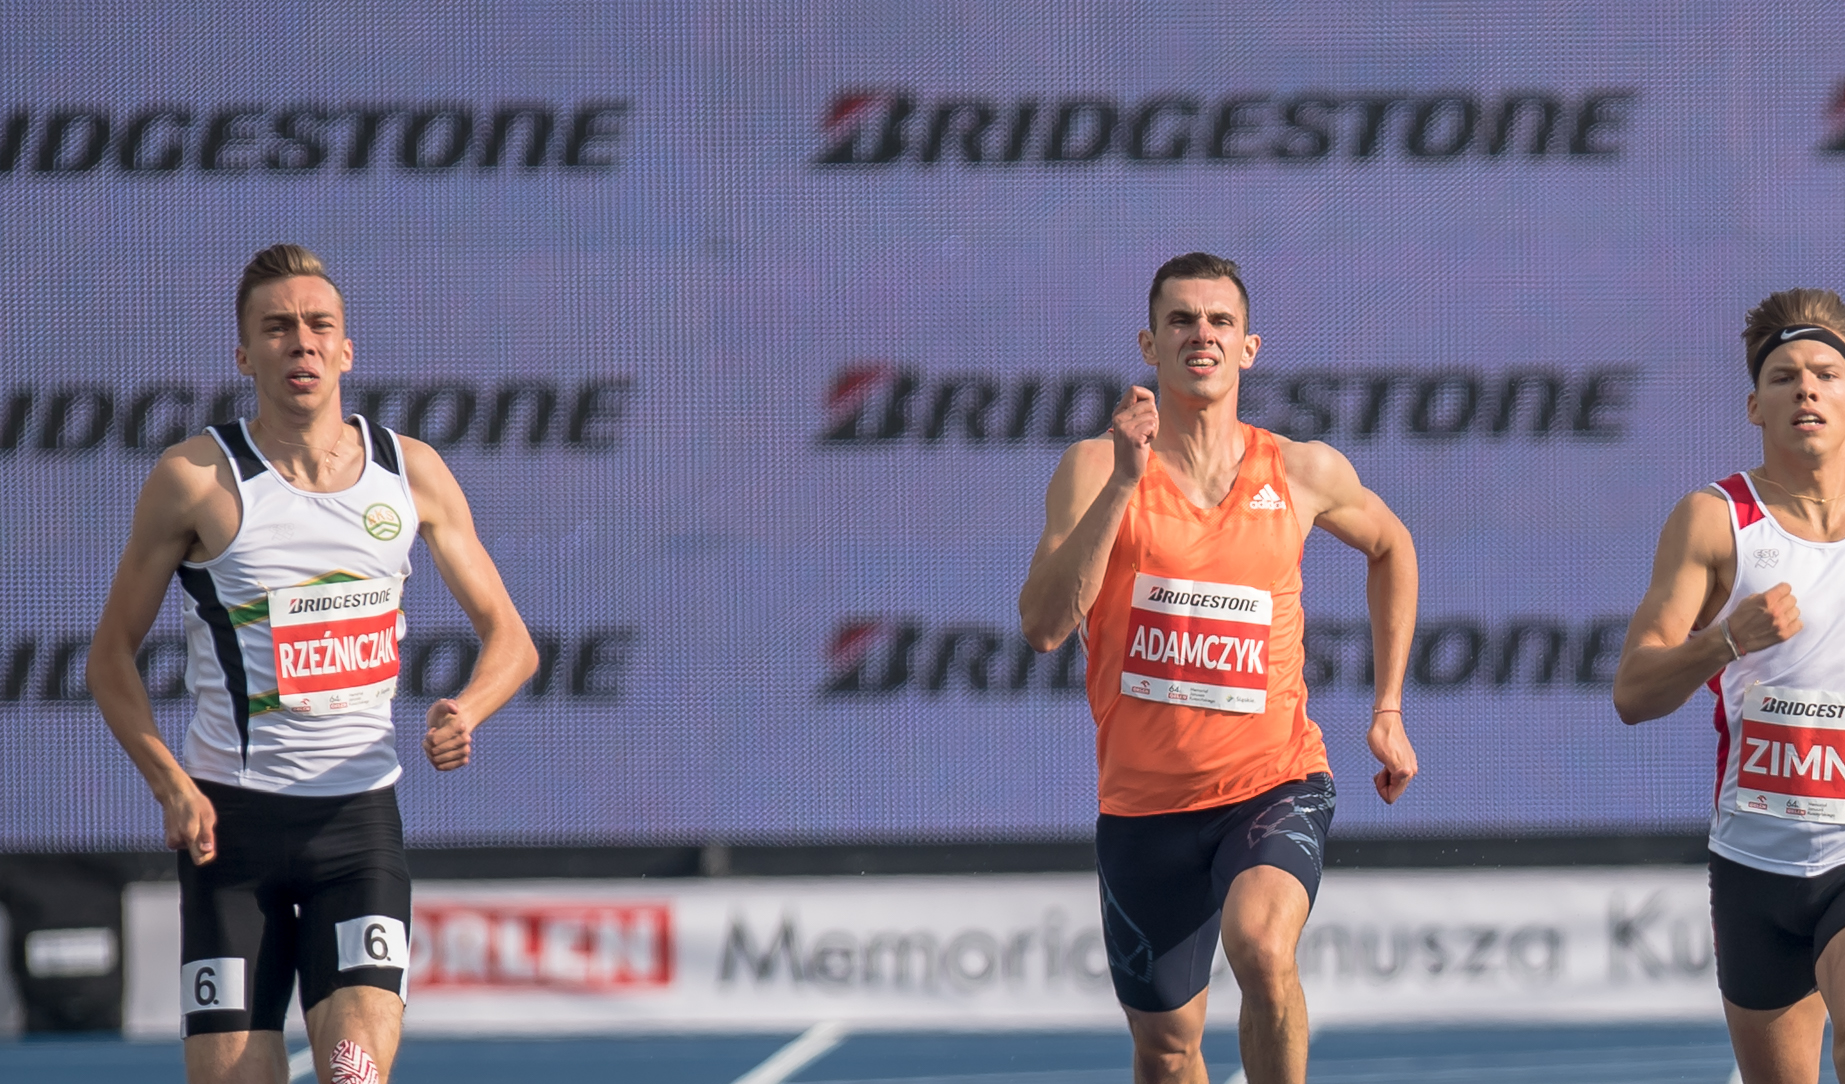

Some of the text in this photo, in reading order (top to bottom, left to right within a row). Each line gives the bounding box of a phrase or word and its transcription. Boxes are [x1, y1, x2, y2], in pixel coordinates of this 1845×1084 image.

[818, 90, 1634, 164] BRIDGESTONE
[820, 368, 1638, 440] BRIDSTONE
[289, 588, 391, 614] BRIDGESTONE
[1148, 586, 1259, 612] BRIDGESTONE
[279, 626, 396, 678] RZEŹNICZAK
[1129, 624, 1264, 674] ADAMCZYK
